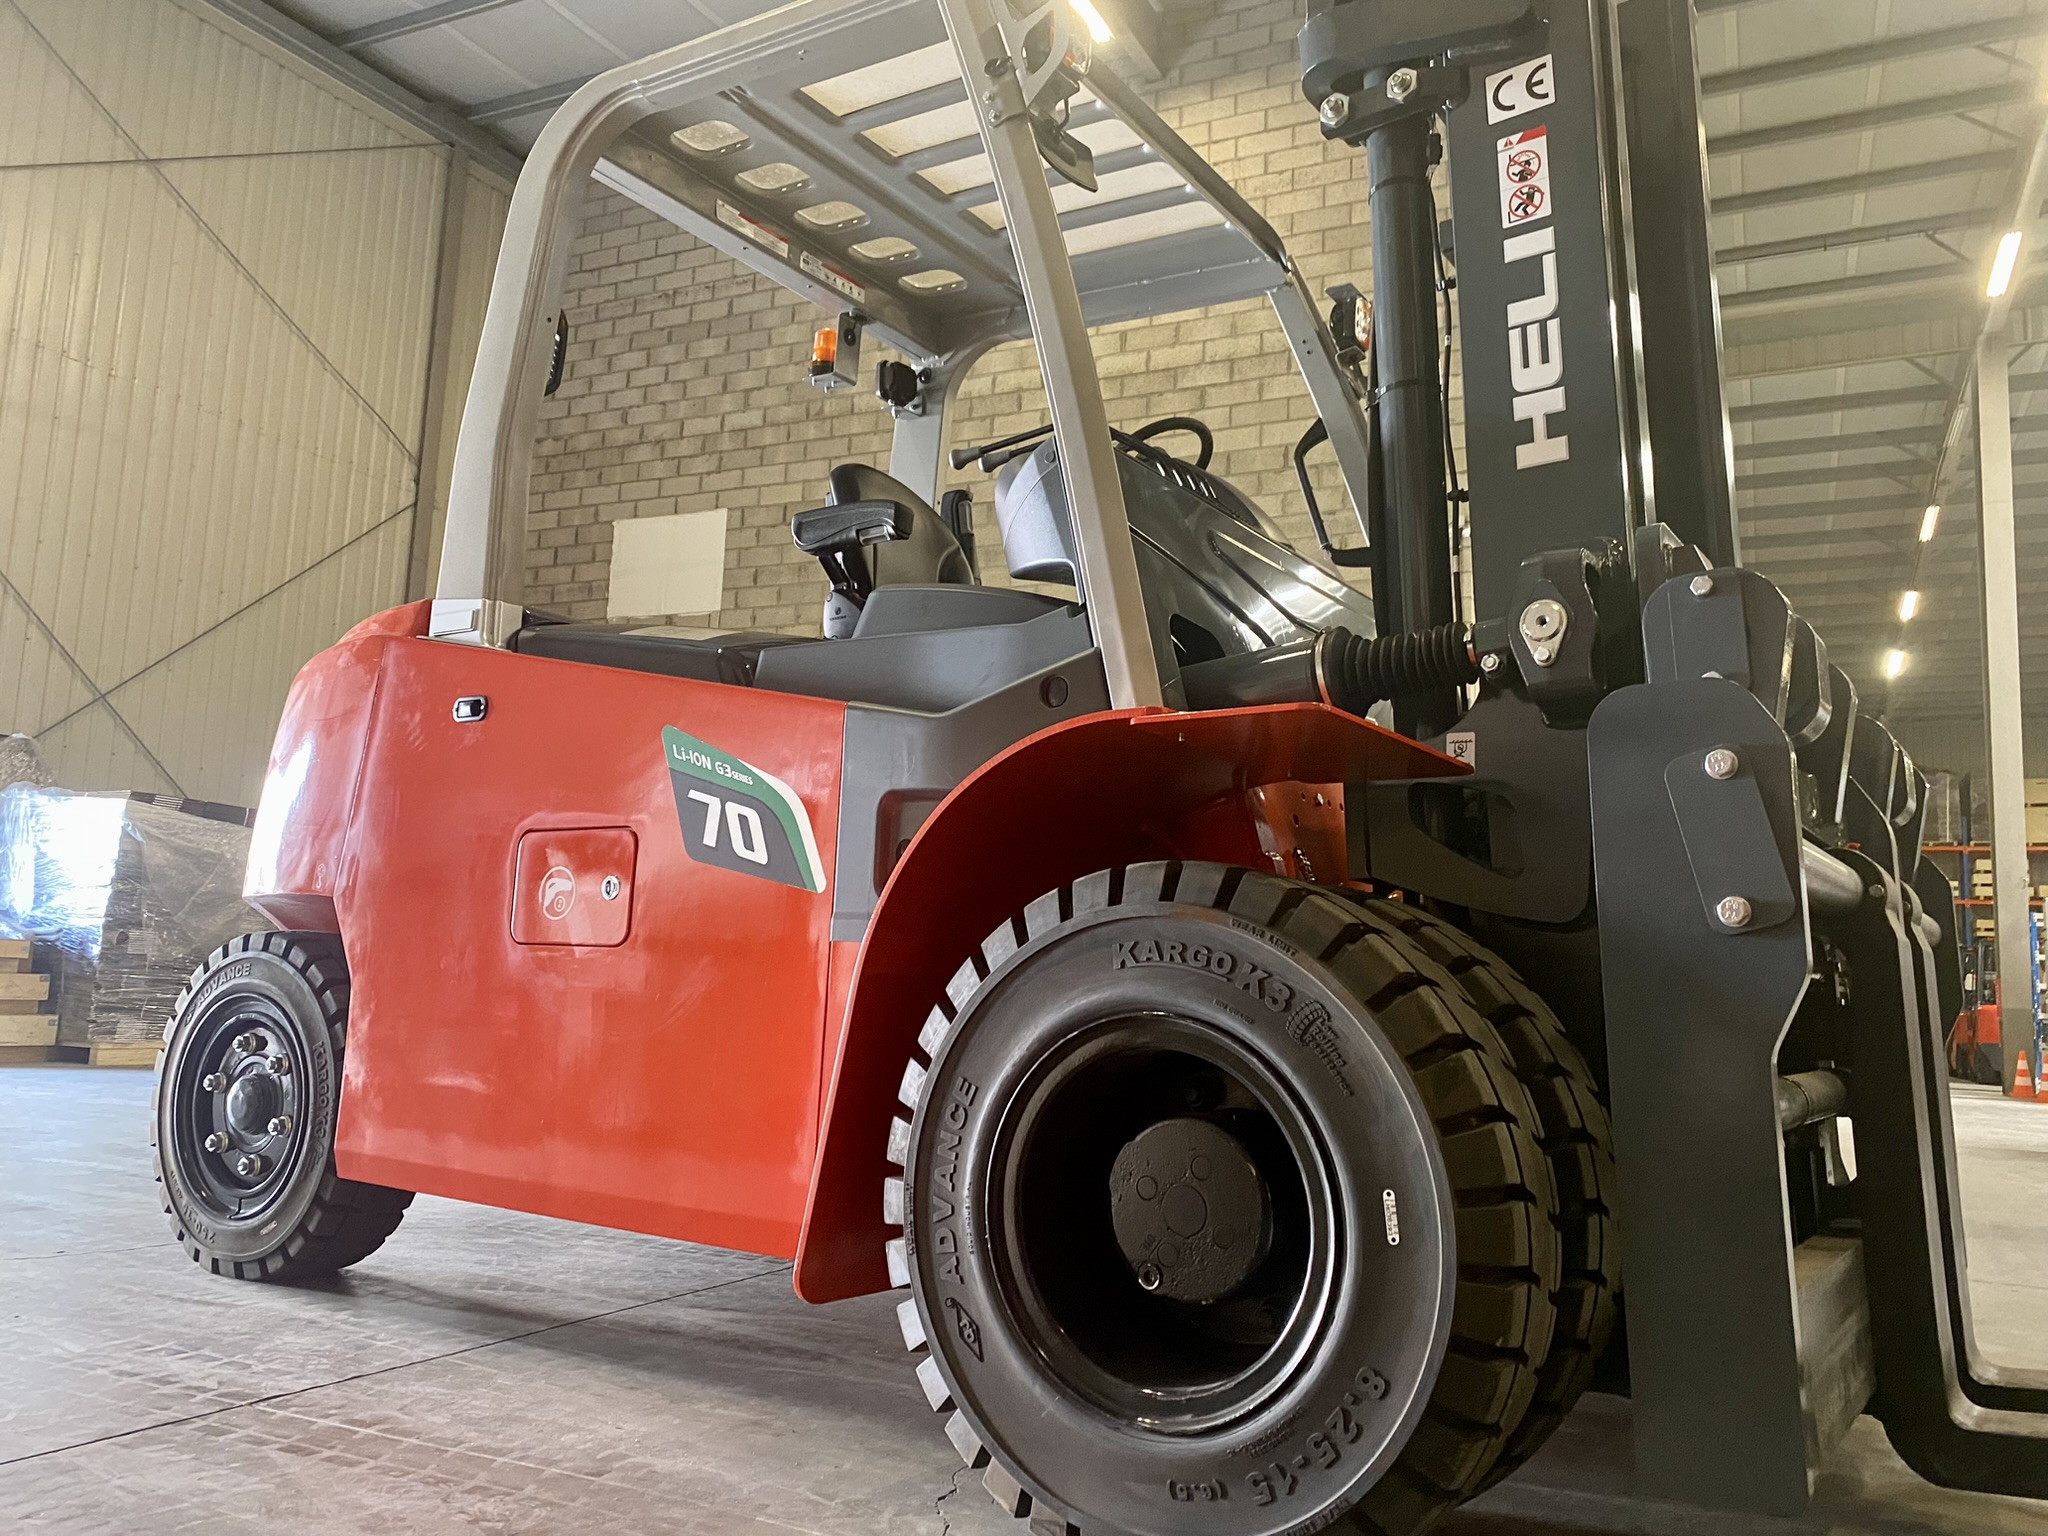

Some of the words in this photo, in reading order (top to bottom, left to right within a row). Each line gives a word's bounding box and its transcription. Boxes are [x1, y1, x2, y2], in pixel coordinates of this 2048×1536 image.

[1492, 62, 1549, 111] CE
[1503, 226, 1570, 470] HELI
[687, 789, 768, 865] 70
[198, 962, 252, 1008] ADVANCE
[1112, 939, 1234, 976] KARGO
[1234, 961, 1296, 1013] K3
[312, 1040, 330, 1107] KARGO
[1302, 1034, 1355, 1098] Resistance
[1311, 1027, 1346, 1069] Rolling
[933, 1076, 978, 1285] ADVANCE
[1244, 1366, 1391, 1507] 8.25-15
